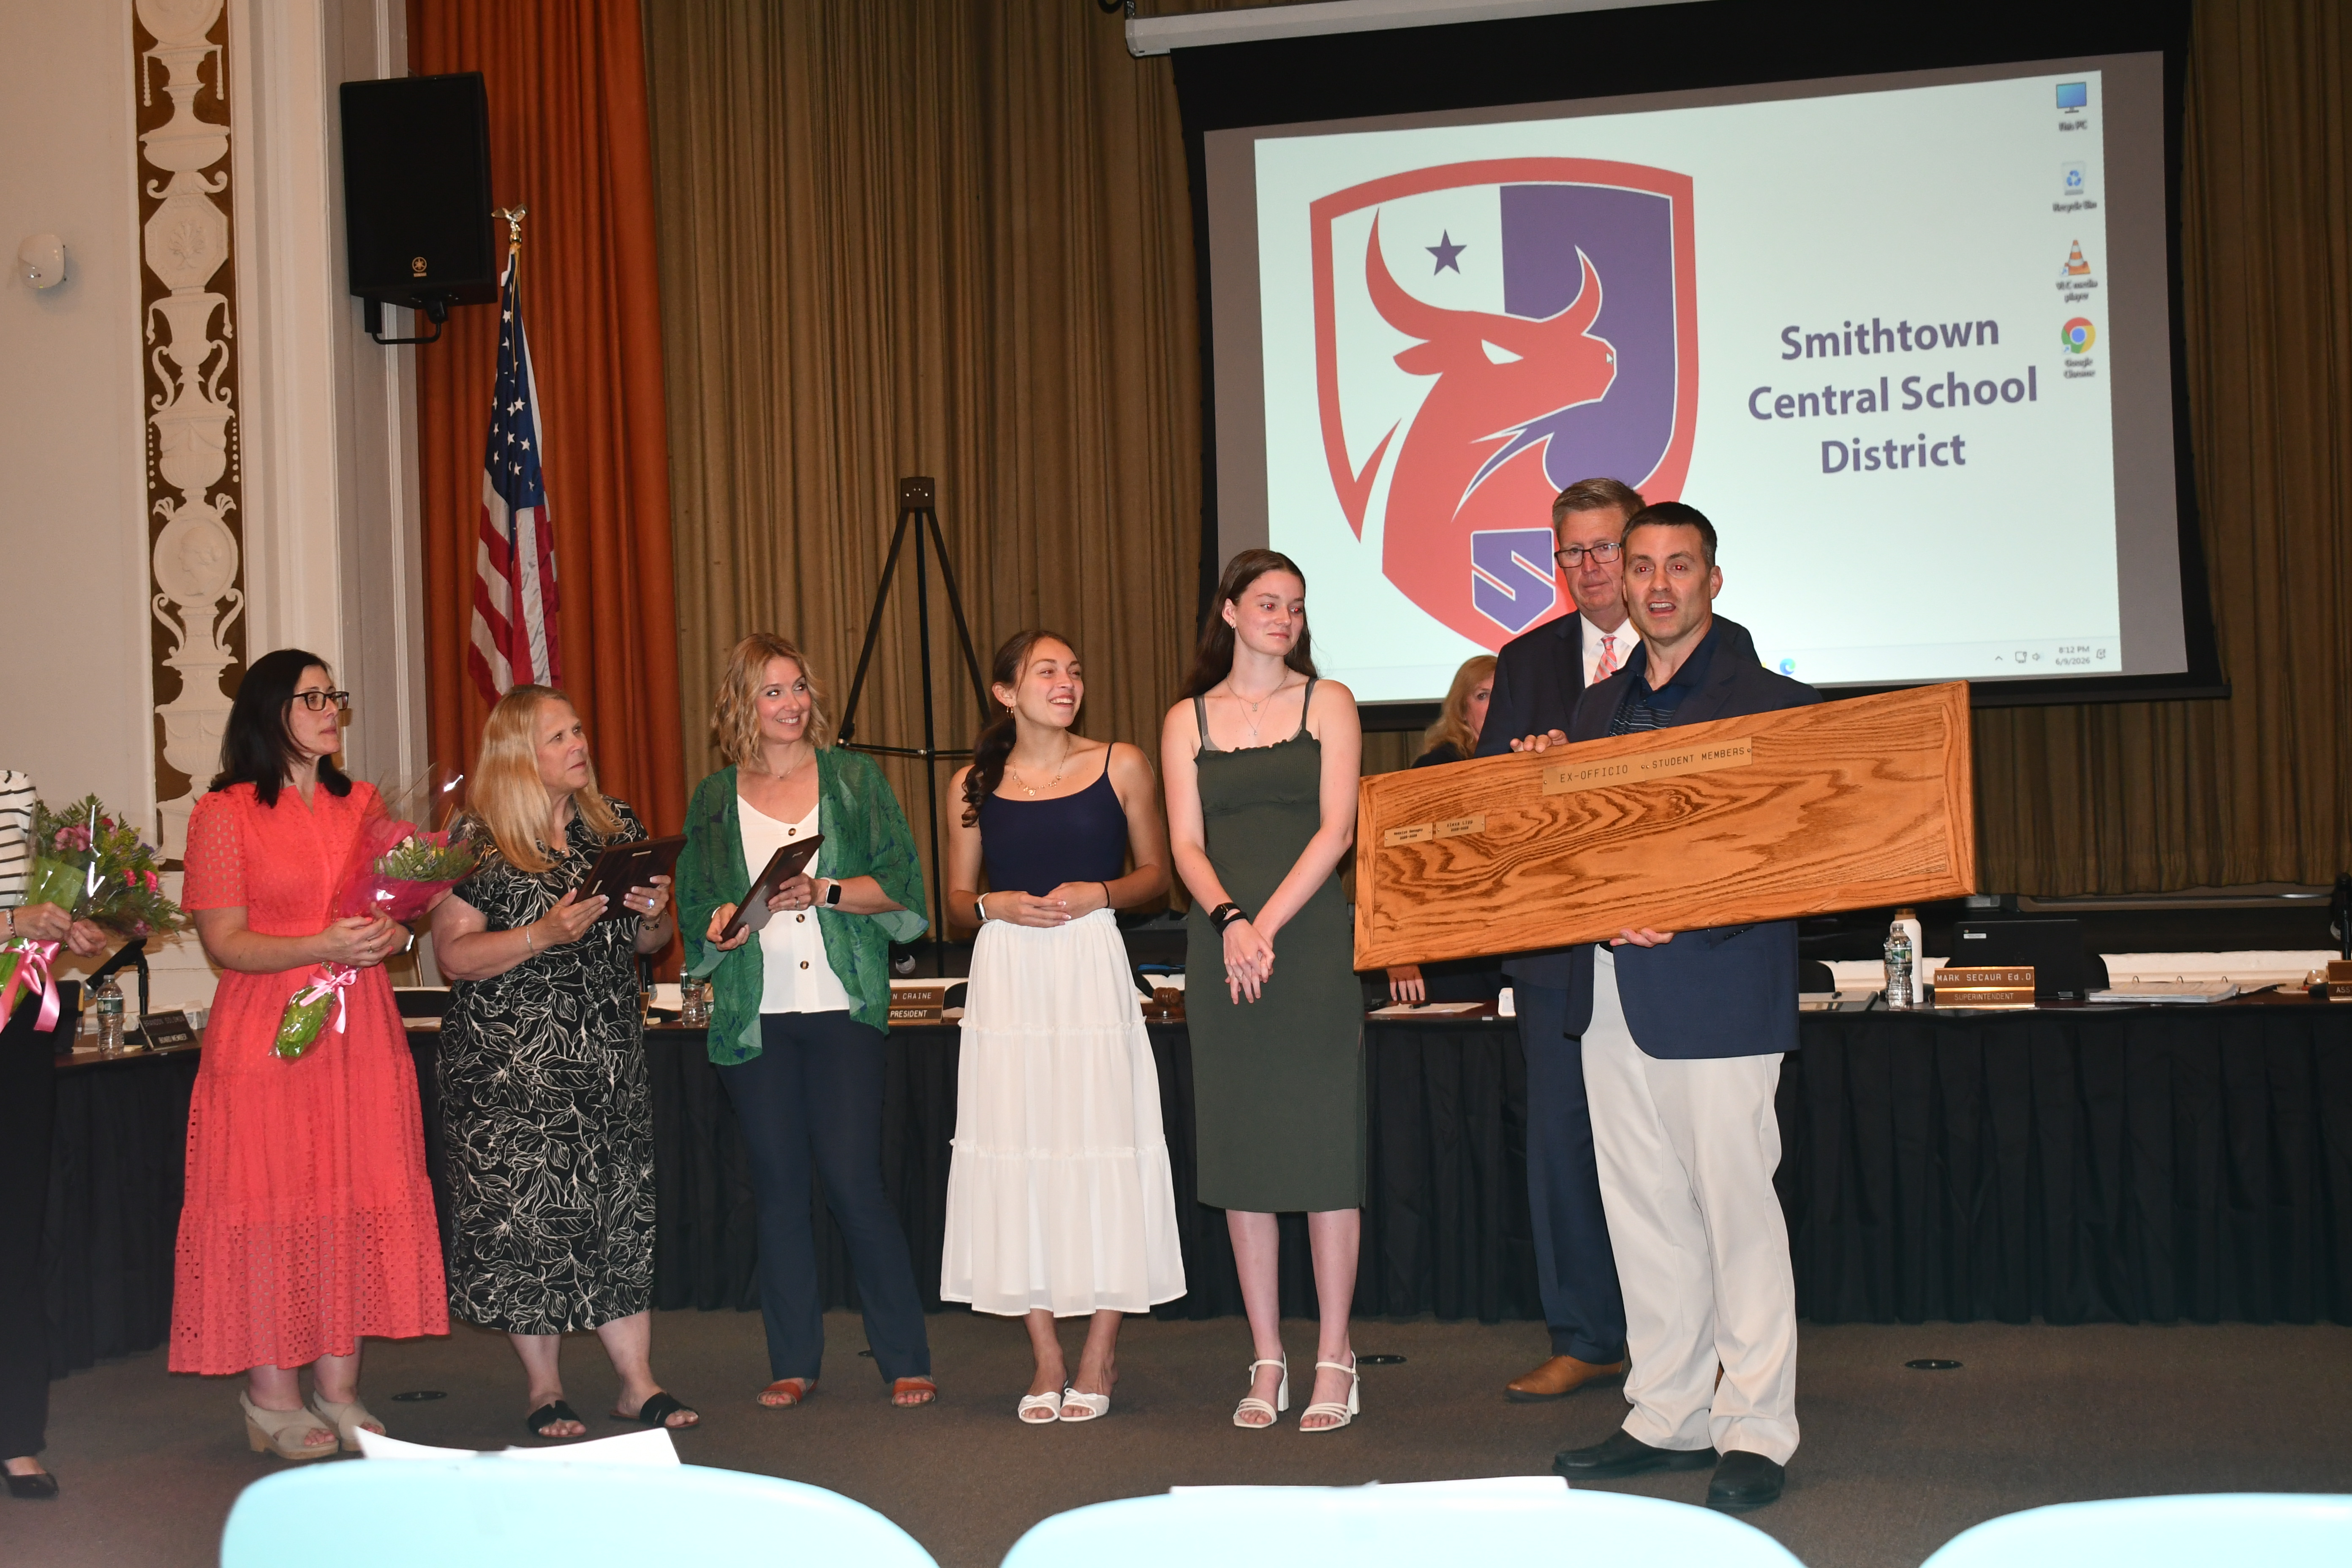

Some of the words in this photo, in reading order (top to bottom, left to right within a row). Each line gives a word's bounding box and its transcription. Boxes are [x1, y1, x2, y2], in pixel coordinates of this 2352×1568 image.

[1780, 318, 1999, 360] Smithtown
[1748, 376, 1889, 420] Central
[1902, 365, 2037, 411] School
[1821, 433, 1966, 474] District
[2055, 657, 2090, 666] 6/9/2026
[1560, 764, 1629, 783] EX-OFFICIO
[1652, 754, 1695, 769] STUDENT
[1701, 747, 1745, 760] MEMBERS
[1966, 973, 2001, 981] SECAUR
[1955, 993, 2014, 1001] SUPERINTENDENT
[890, 1010, 928, 1018] PRESIDENT
